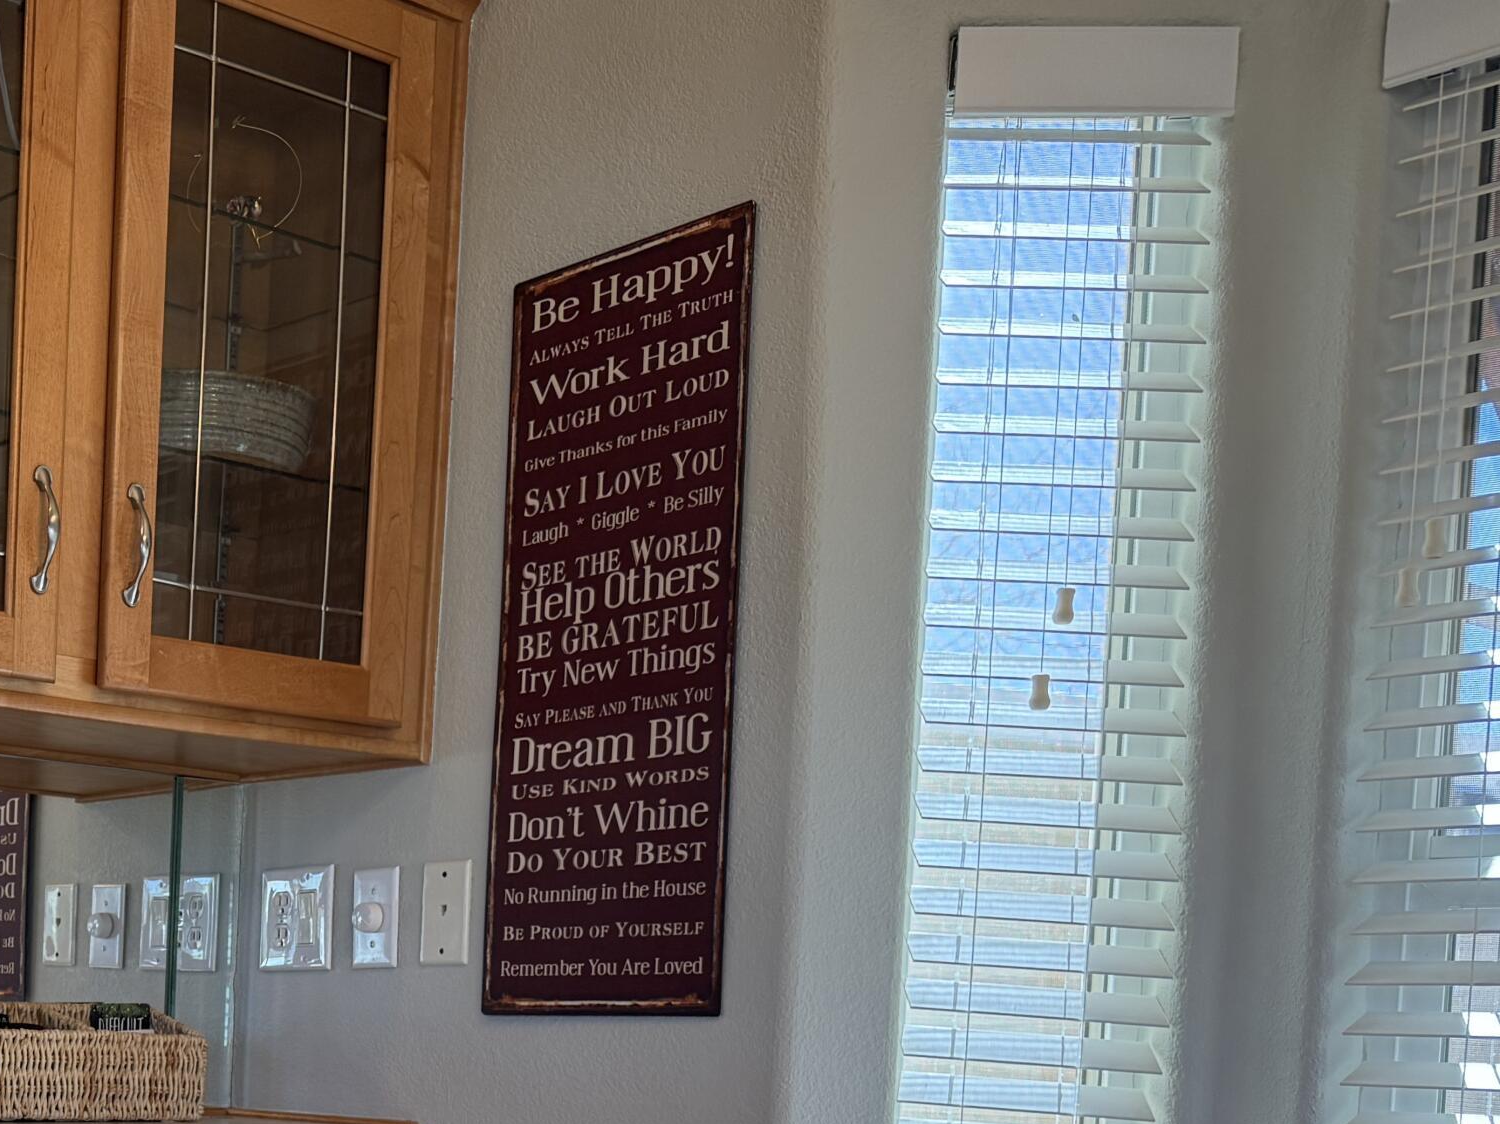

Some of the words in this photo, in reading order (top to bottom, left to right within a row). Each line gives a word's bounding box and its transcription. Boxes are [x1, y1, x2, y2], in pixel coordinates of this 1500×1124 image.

[532, 297, 580, 334] Be
[591, 234, 734, 314] Happy!
[529, 335, 589, 366] ALWAYS
[595, 323, 634, 345] TELL
[640, 310, 672, 331] THE
[678, 288, 733, 317] TRUTH
[529, 355, 630, 405] Work
[640, 320, 731, 376] Hard
[526, 405, 600, 442] LAUGH
[609, 390, 656, 418] OUT
[665, 368, 730, 402] LOUD
[524, 453, 555, 473] Give
[559, 439, 613, 464] Thanks
[616, 432, 637, 449] for
[641, 422, 670, 441] this
[674, 408, 728, 434] Family
[524, 485, 571, 518] SAY
[580, 477, 586, 504] I
[596, 461, 662, 501] LOVE
[672, 445, 727, 482] YOU
[522, 518, 569, 548] Laugh
[591, 504, 640, 533] Giggle
[664, 496, 684, 514] Be
[687, 484, 724, 509] Silly
[521, 561, 566, 591] SEE
[575, 548, 620, 580] THE
[629, 526, 723, 566] WORLD
[520, 582, 596, 628] Help
[604, 558, 720, 609] Others
[517, 631, 552, 663] BE
[561, 603, 719, 655] GRATEFUL
[517, 667, 556, 698] Try
[563, 658, 620, 686] New
[627, 640, 716, 677] Things
[514, 713, 540, 729] SAY
[545, 705, 595, 725] PLEASE
[600, 701, 627, 717] AND
[631, 692, 678, 713] THANK
[683, 687, 713, 704] YOU
[510, 729, 635, 775] Dream
[647, 713, 713, 759] BIG
[511, 783, 554, 801] USE
[562, 777, 616, 795] KIND
[625, 766, 710, 789] WORDS
[508, 806, 586, 843] Don't
[594, 798, 709, 836] Whine
[507, 851, 543, 874] DO
[552, 847, 624, 871] YOUR
[635, 841, 707, 866] BEST
[504, 888, 524, 905] No
[528, 884, 597, 905] Running
[601, 882, 617, 900] in
[622, 881, 650, 899] the
[653, 879, 706, 898] House
[503, 926, 524, 941] BE
[530, 925, 583, 940] PROUD
[589, 924, 610, 938] OF
[615, 921, 704, 938] YOURSELF
[500, 959, 585, 977] Remember
[589, 958, 618, 976] You
[621, 958, 650, 975] Are
[654, 957, 703, 975] Loved
